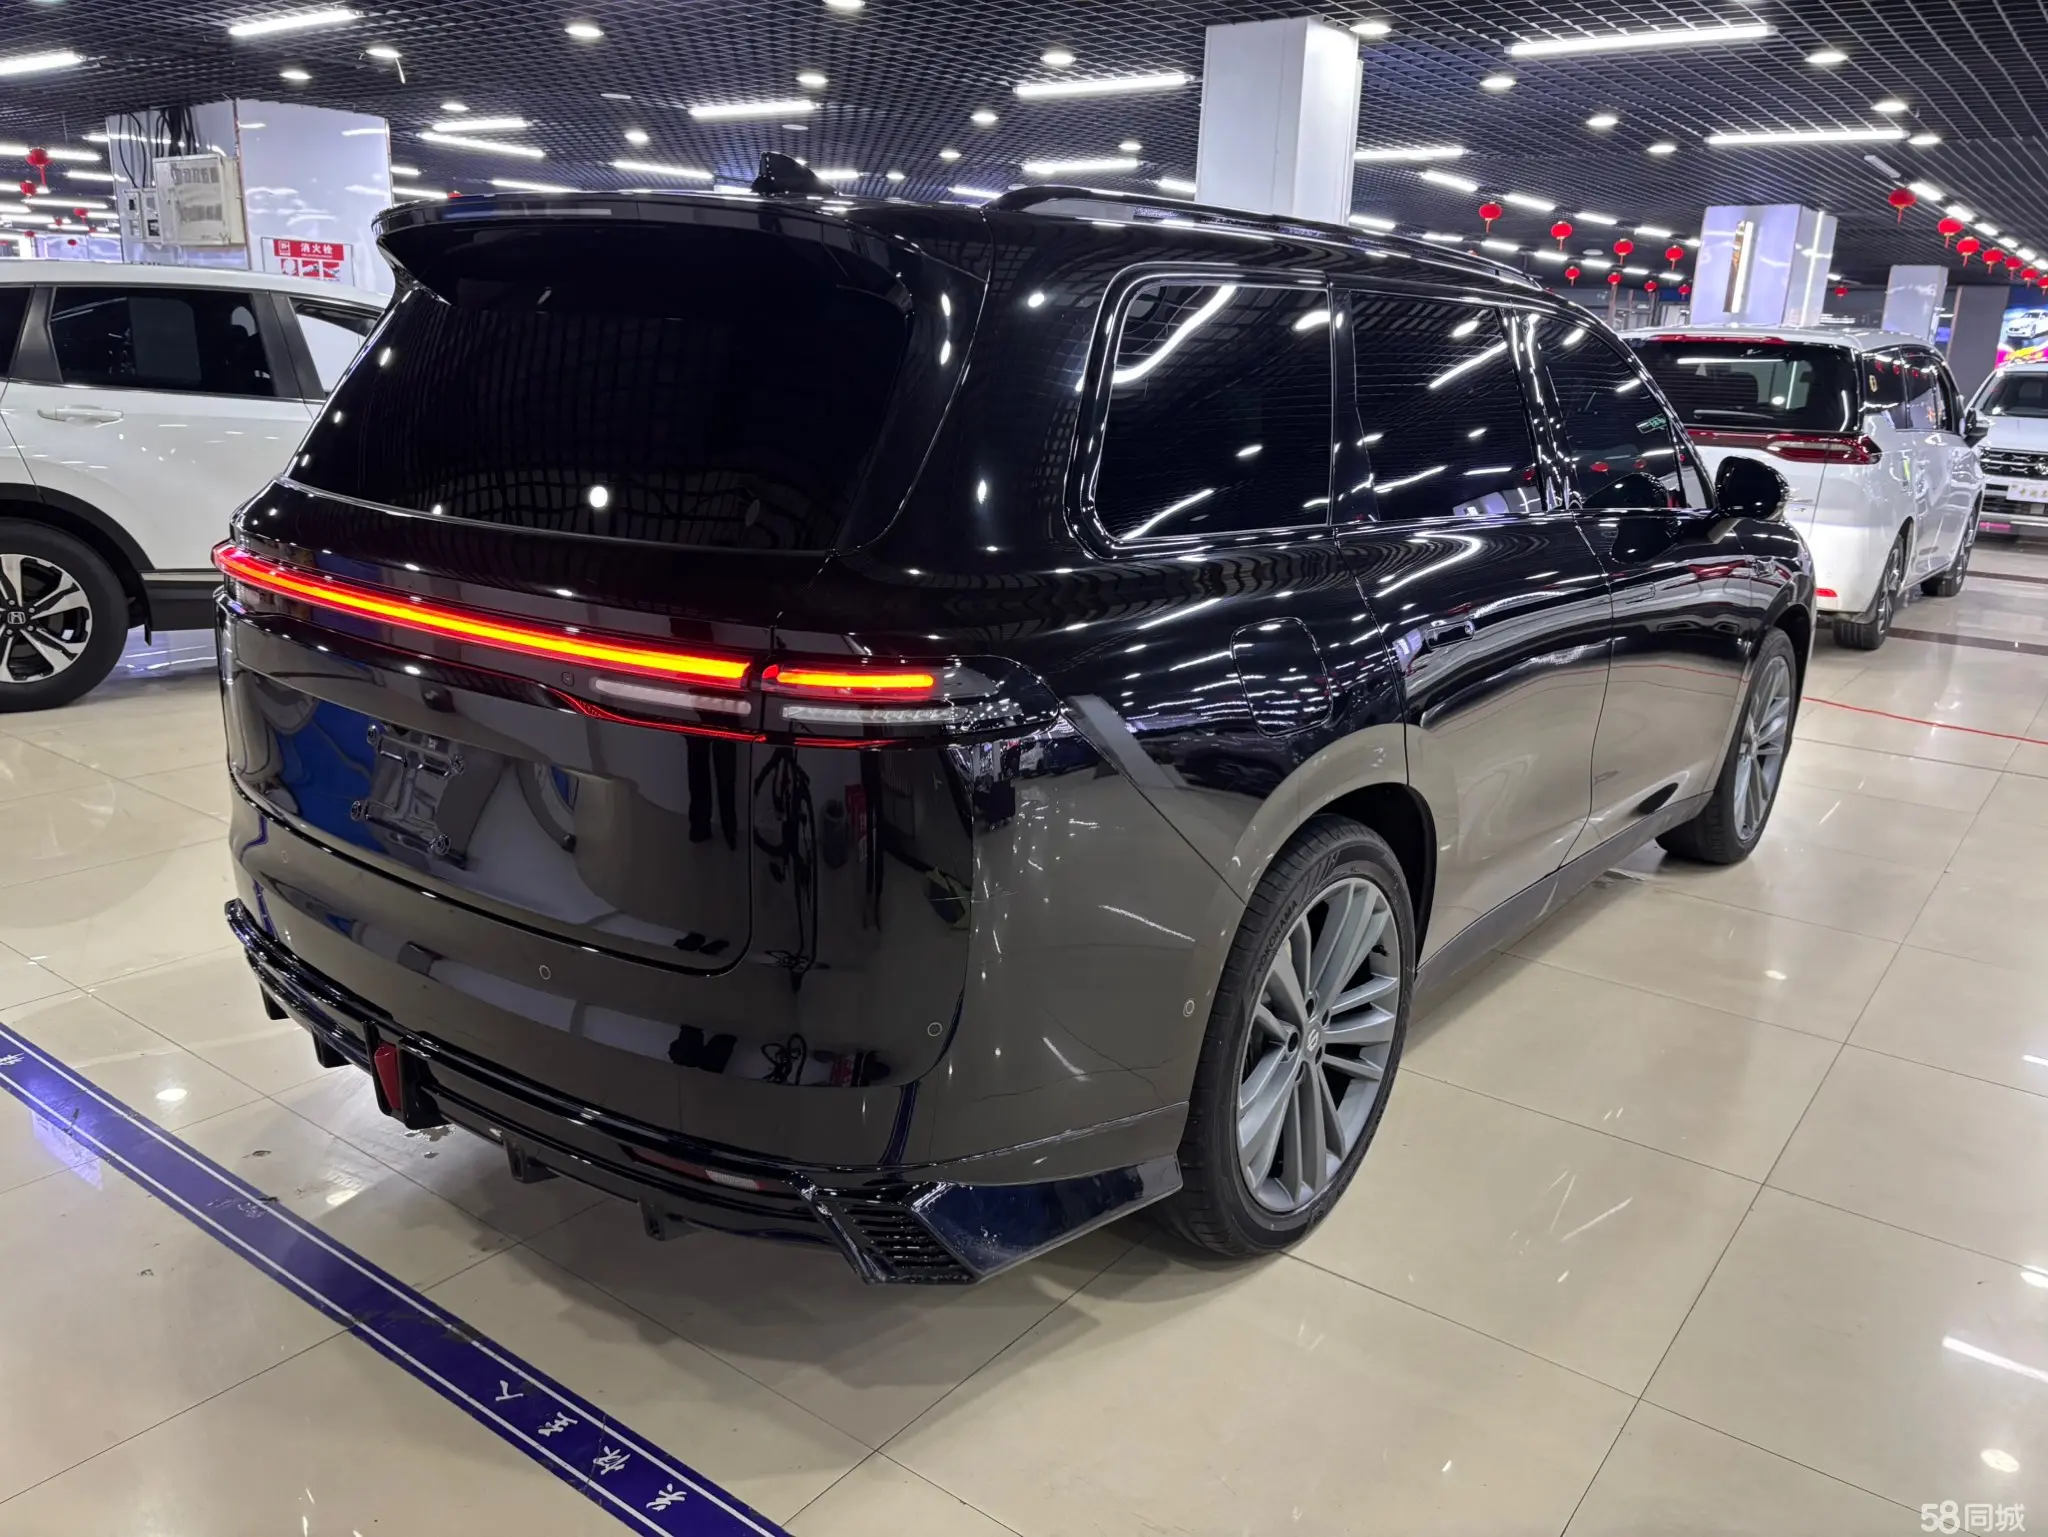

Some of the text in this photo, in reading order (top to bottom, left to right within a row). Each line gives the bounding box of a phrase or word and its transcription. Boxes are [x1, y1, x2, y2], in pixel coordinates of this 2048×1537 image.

[300, 242, 333, 254] 消火栓
[1256, 900, 1298, 972] YOKOHAMA
